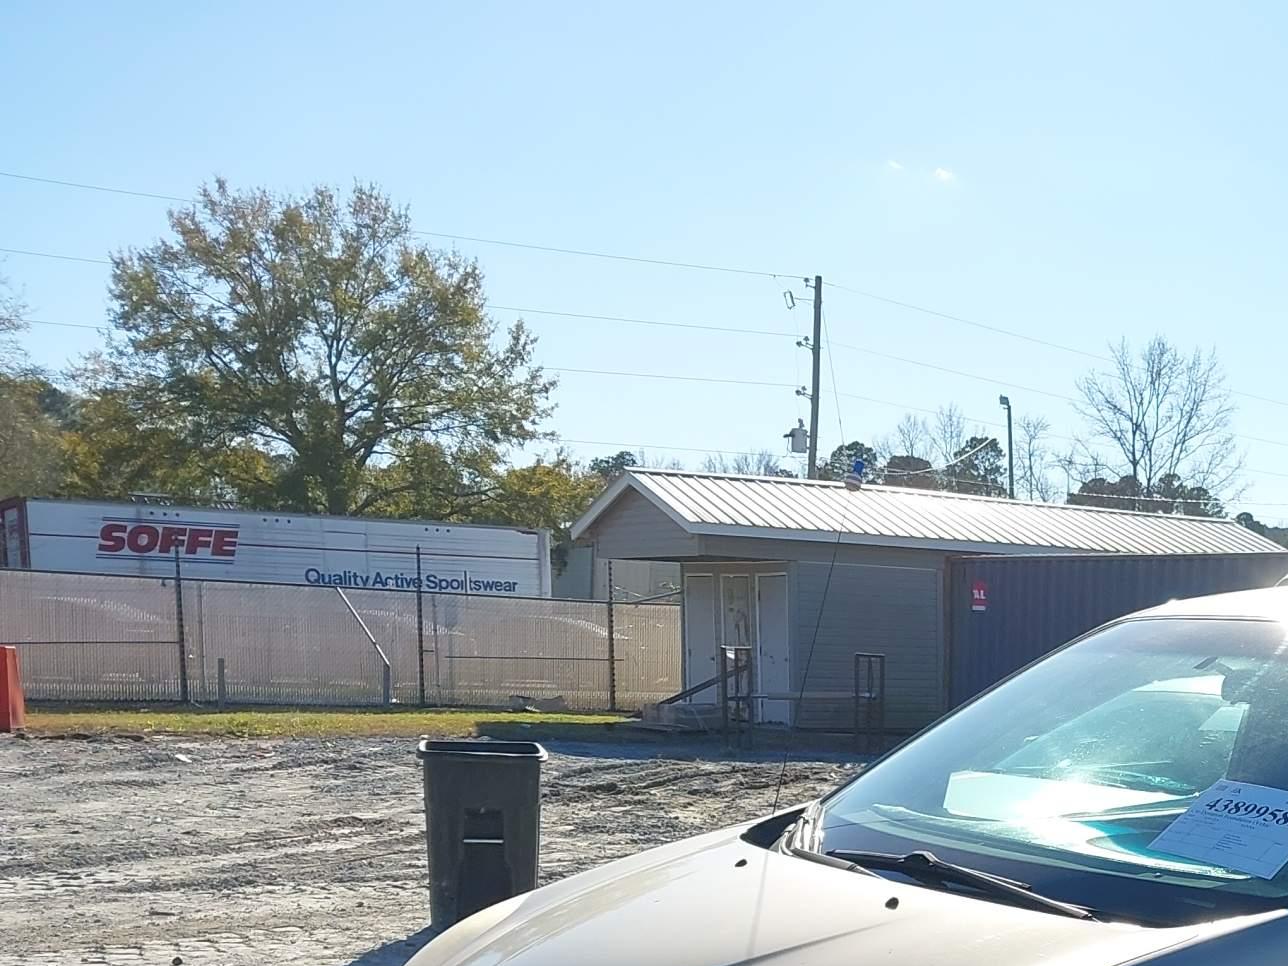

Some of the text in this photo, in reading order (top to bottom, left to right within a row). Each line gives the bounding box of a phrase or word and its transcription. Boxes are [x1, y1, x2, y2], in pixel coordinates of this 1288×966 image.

[98, 523, 239, 557] SOFFE
[304, 567, 370, 587] Quality
[372, 571, 423, 589] Active
